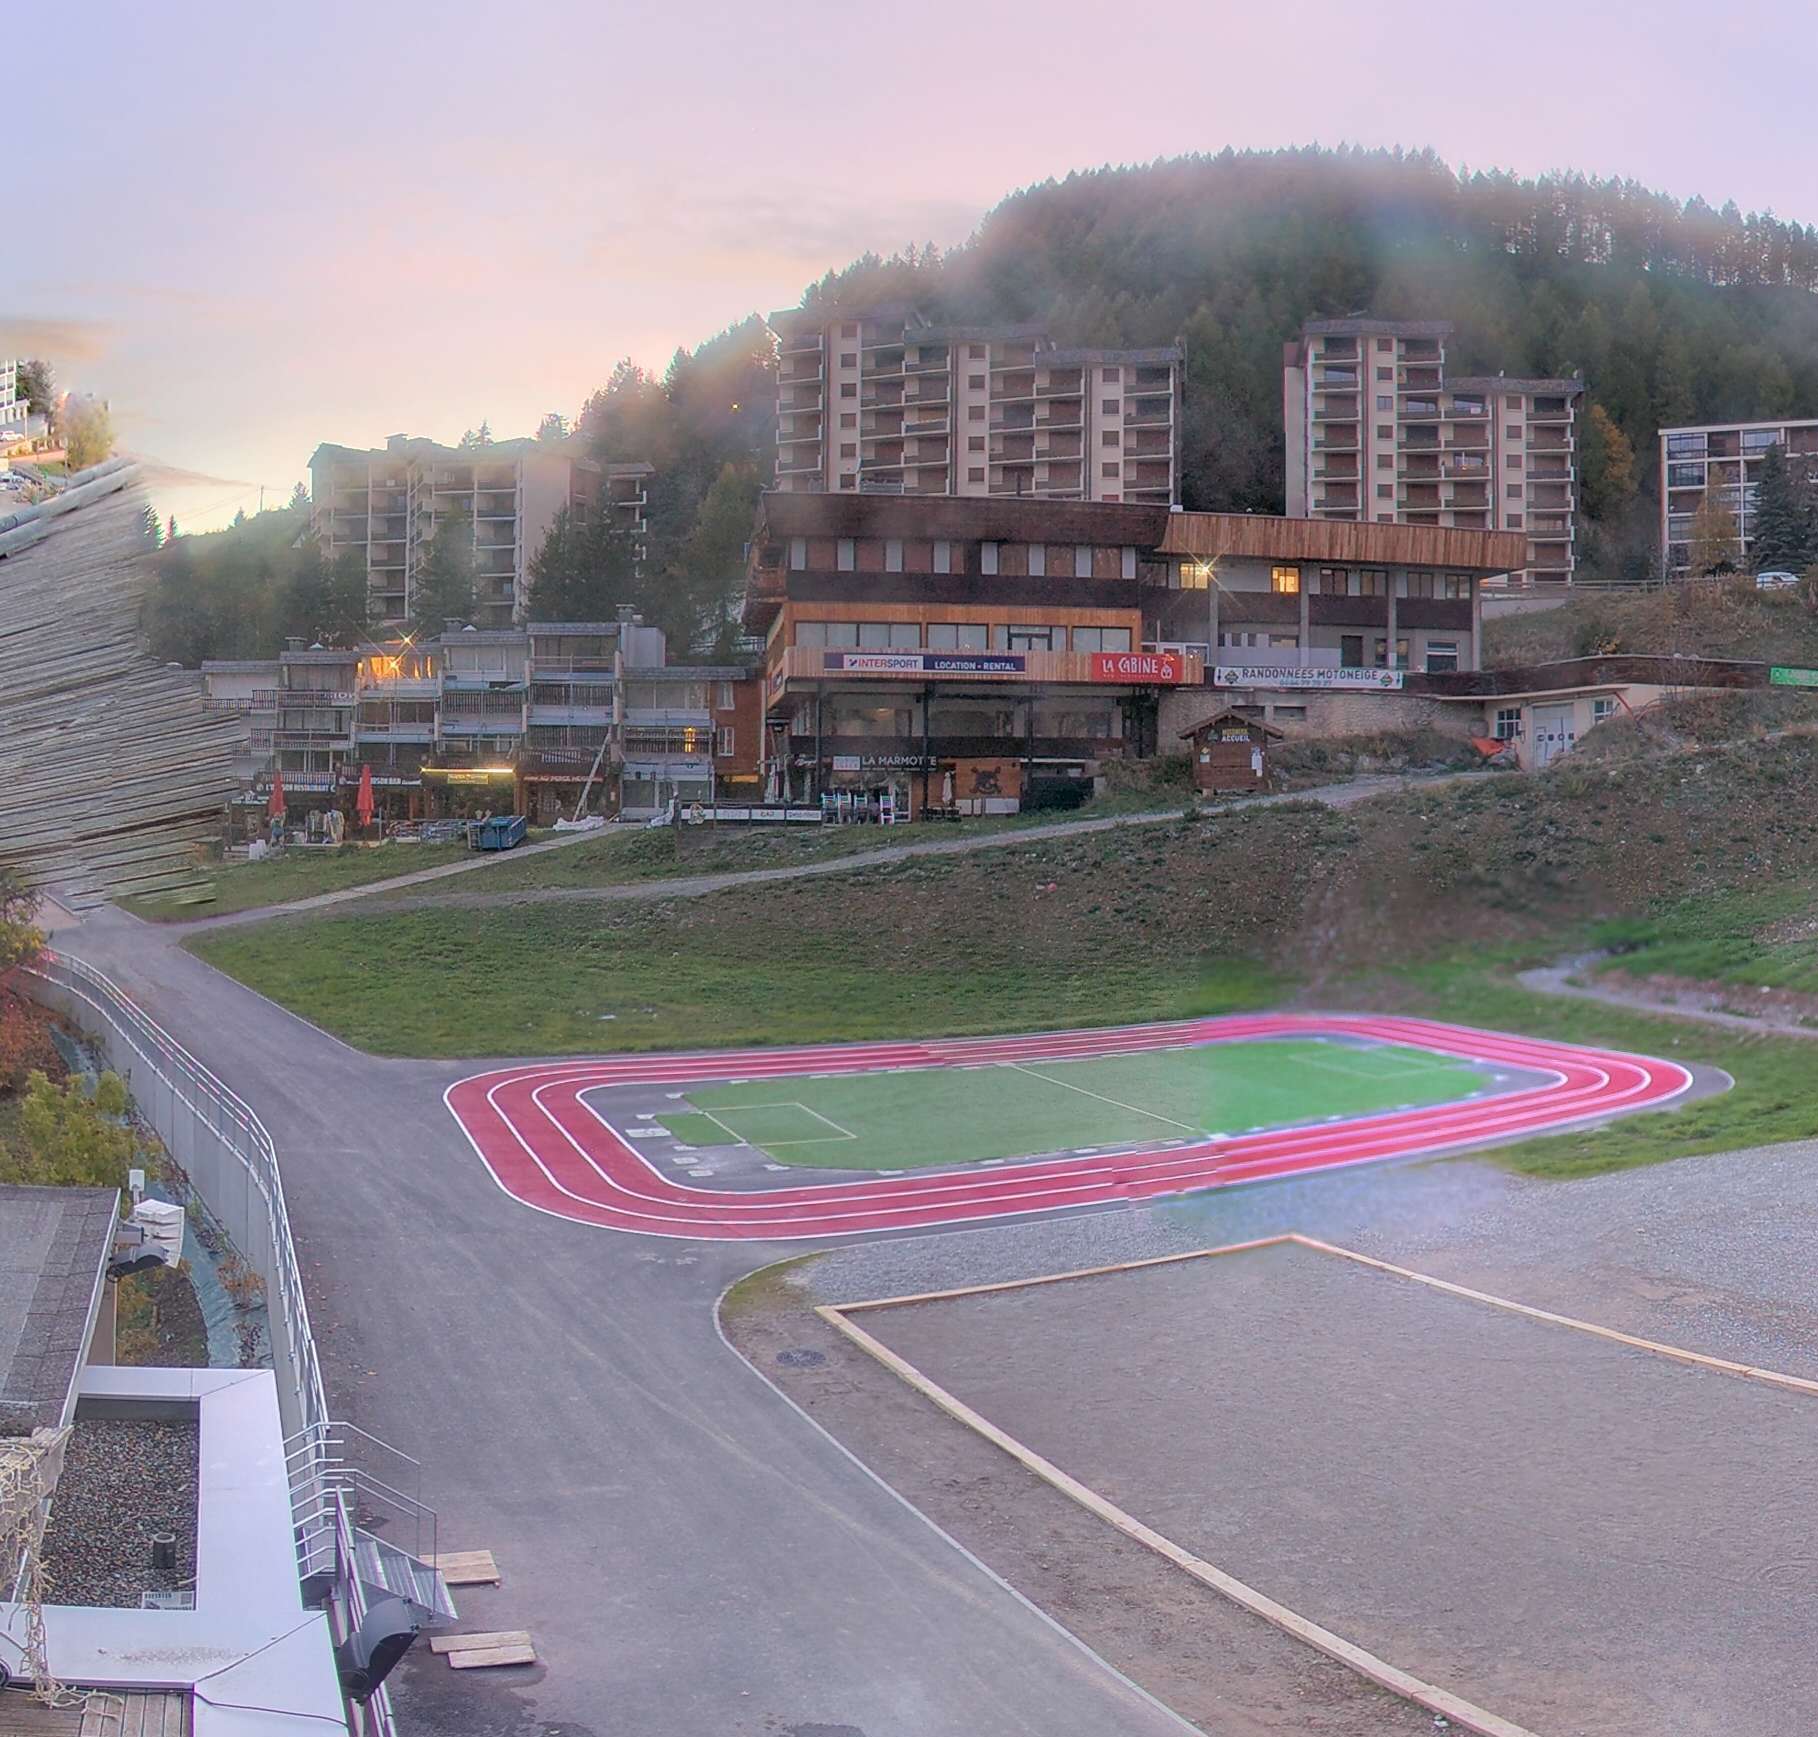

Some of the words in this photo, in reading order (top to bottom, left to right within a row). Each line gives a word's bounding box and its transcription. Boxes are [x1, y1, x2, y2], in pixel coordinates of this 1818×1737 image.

[858, 656, 919, 668] INTERSPORT
[935, 661, 976, 670] LOCATION
[983, 662, 1016, 671] RENTAL
[1103, 659, 1114, 673] LA
[1317, 670, 1378, 681] MOTONEIGE
[862, 756, 875, 765] LA
[879, 756, 936, 766] MARMOTE
